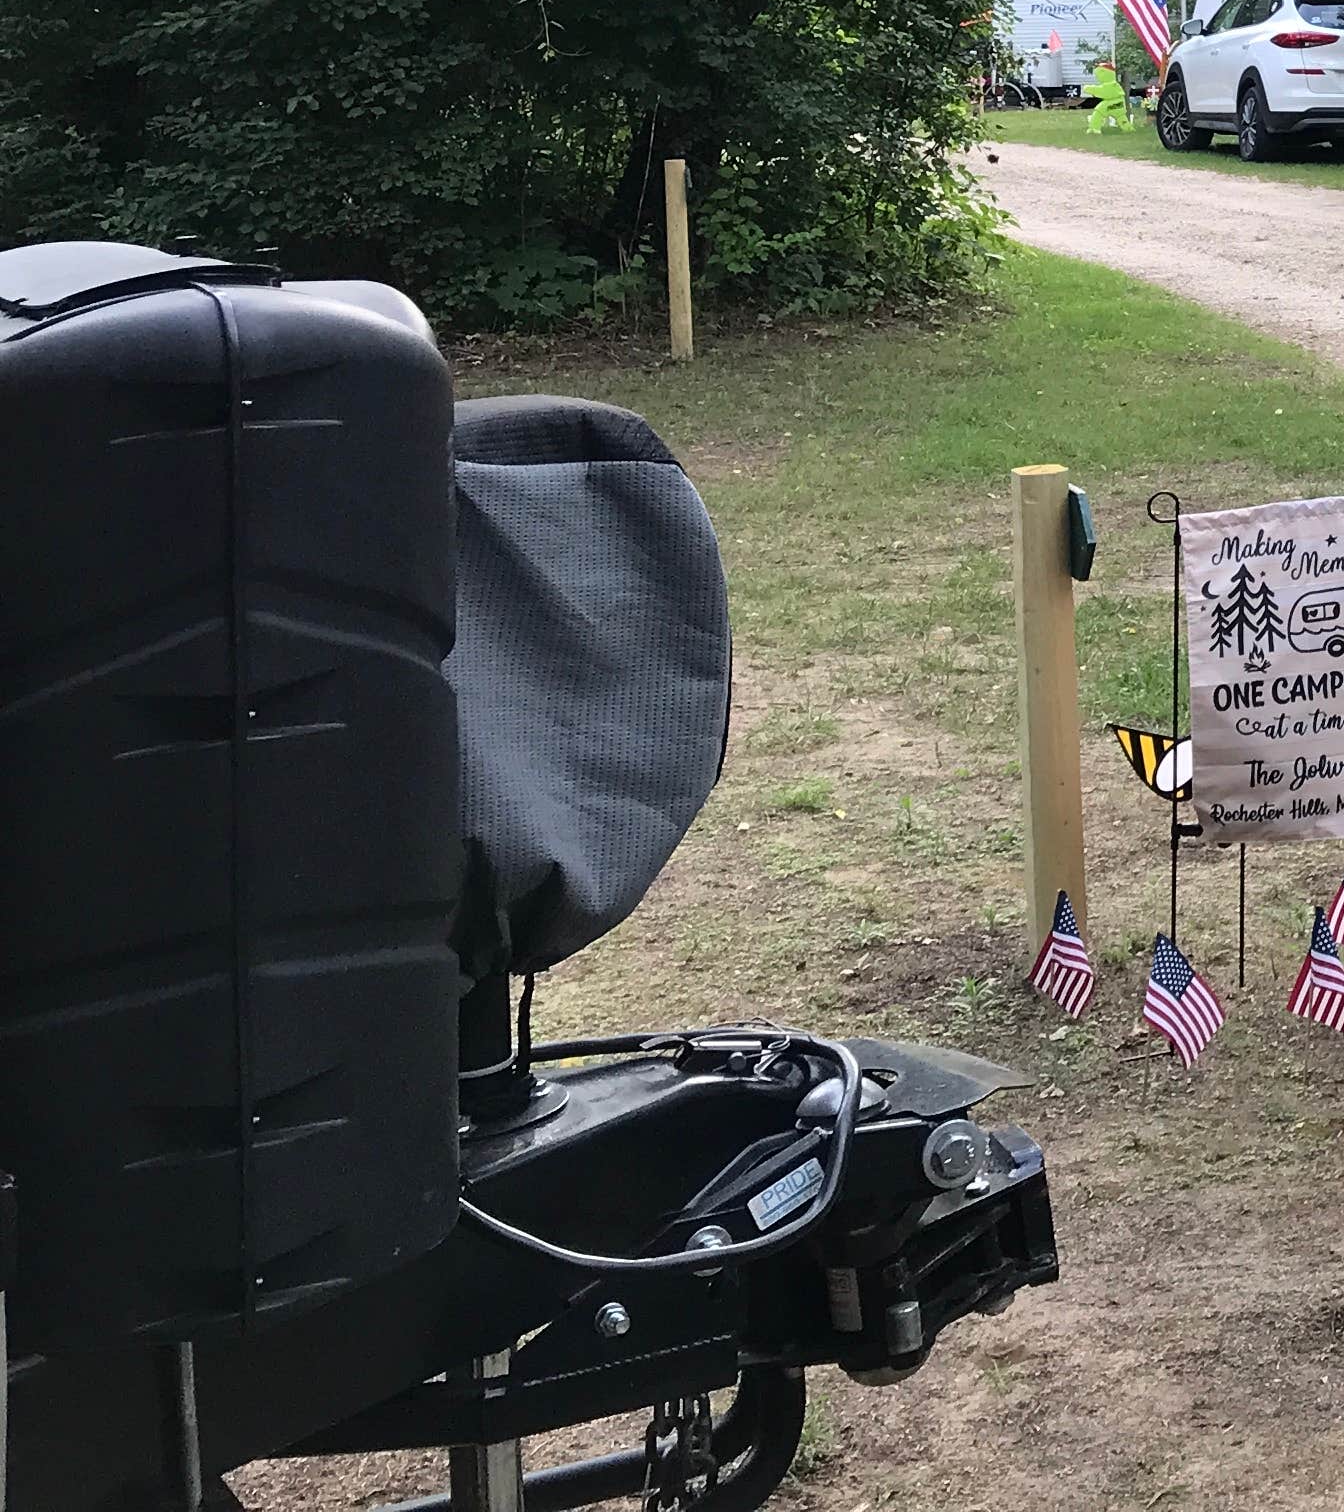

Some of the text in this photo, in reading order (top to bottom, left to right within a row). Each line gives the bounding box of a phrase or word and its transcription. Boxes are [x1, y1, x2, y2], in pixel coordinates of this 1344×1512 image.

[1211, 528, 1297, 572] Making
[1213, 680, 1266, 712] ONE
[1236, 712, 1291, 739] at
[1293, 720, 1310, 736] a
[1243, 759, 1285, 788] The
[1210, 801, 1285, 827] Rochester
[1289, 797, 1330, 820] Hills,
[761, 1160, 821, 1209] PRIDE
